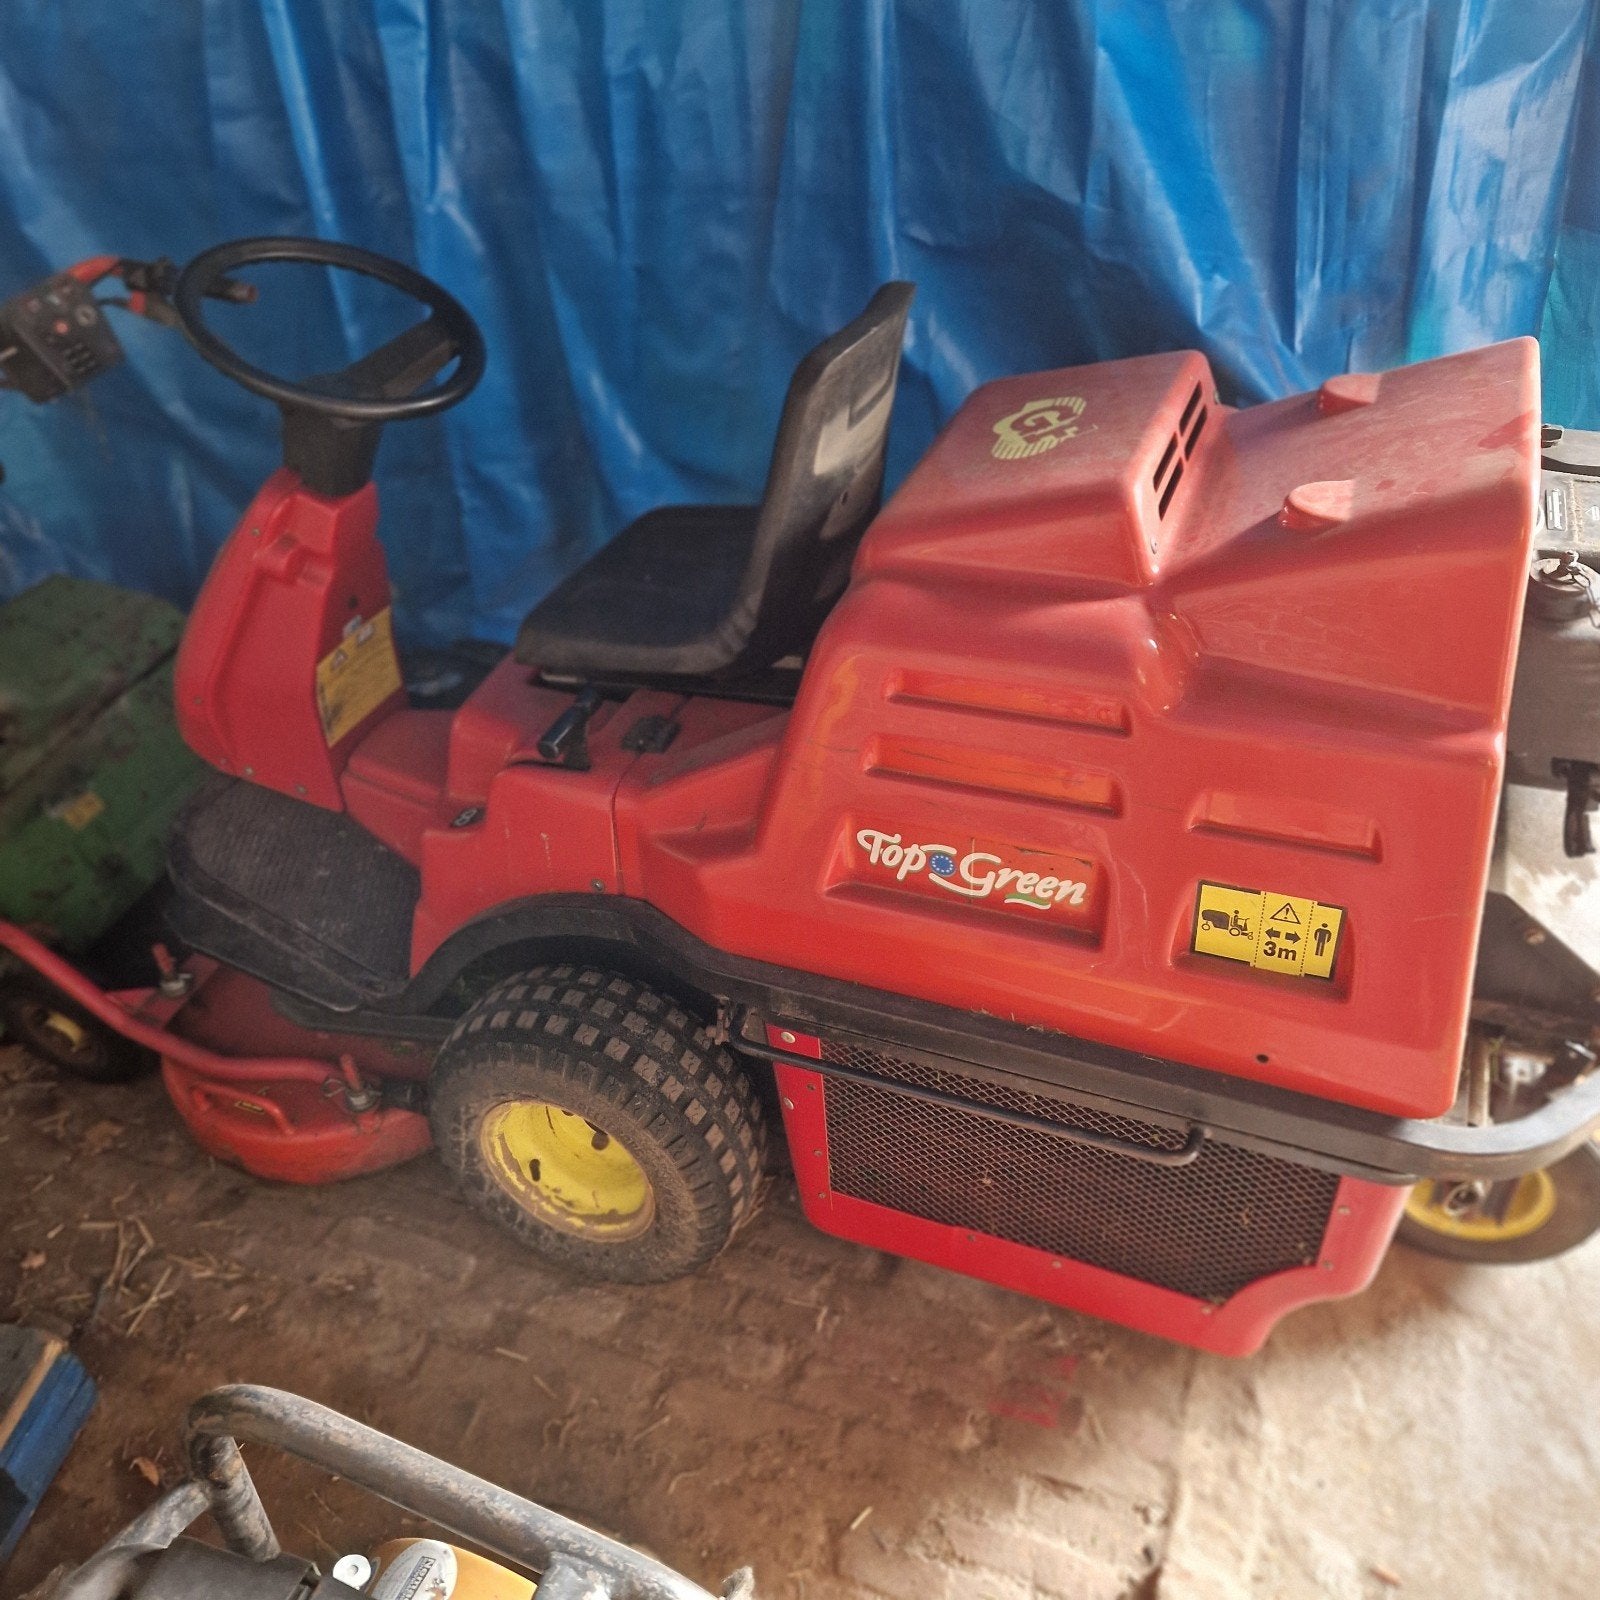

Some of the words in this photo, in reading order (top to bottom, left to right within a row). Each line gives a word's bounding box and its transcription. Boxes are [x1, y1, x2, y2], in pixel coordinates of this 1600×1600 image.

[857, 829, 927, 880] Top
[930, 852, 1087, 905] Green
[1263, 940, 1297, 961] 3m
